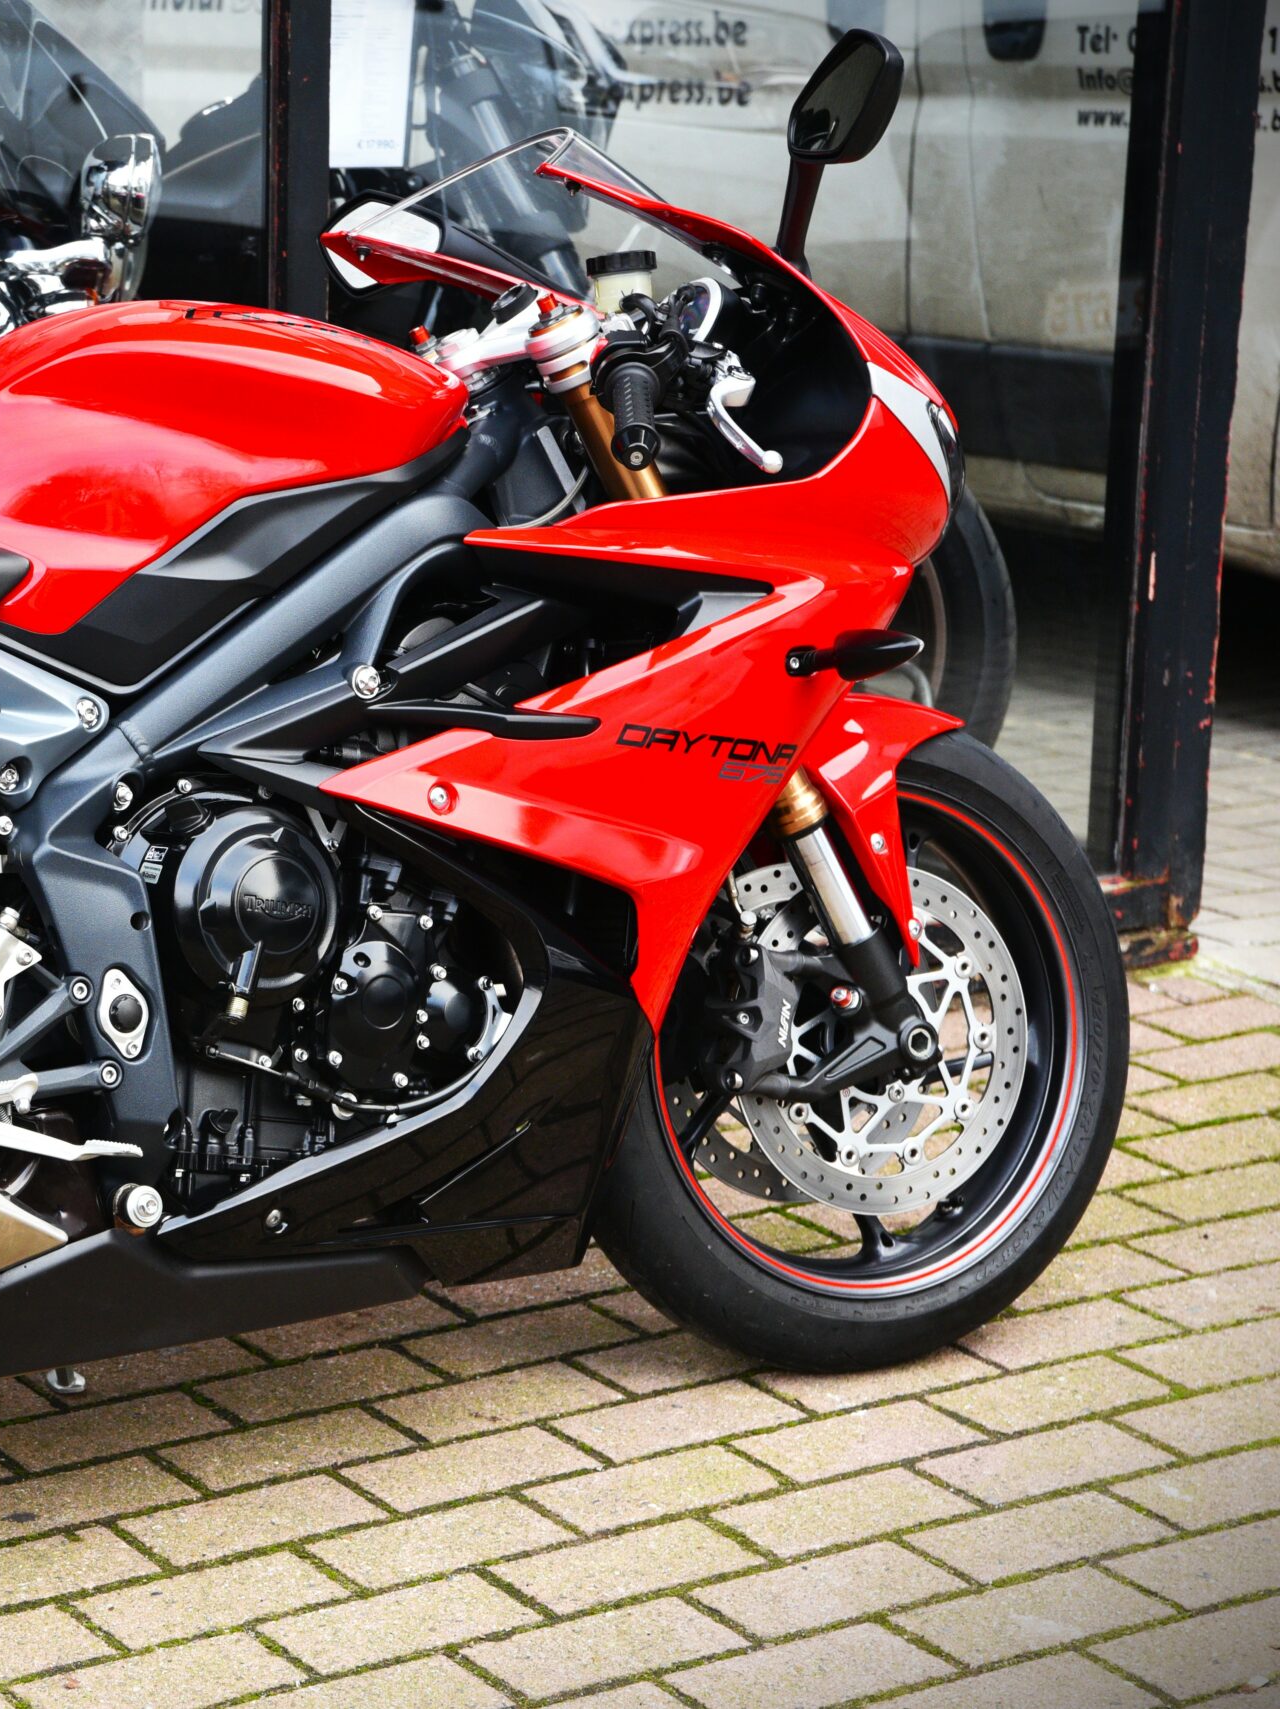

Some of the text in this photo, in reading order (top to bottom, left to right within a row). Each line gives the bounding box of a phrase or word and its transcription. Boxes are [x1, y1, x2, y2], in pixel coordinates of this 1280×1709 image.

[616, 723, 798, 764] DAYTONA
[718, 761, 788, 784] 675
[243, 894, 313, 920] TRIUMPH
